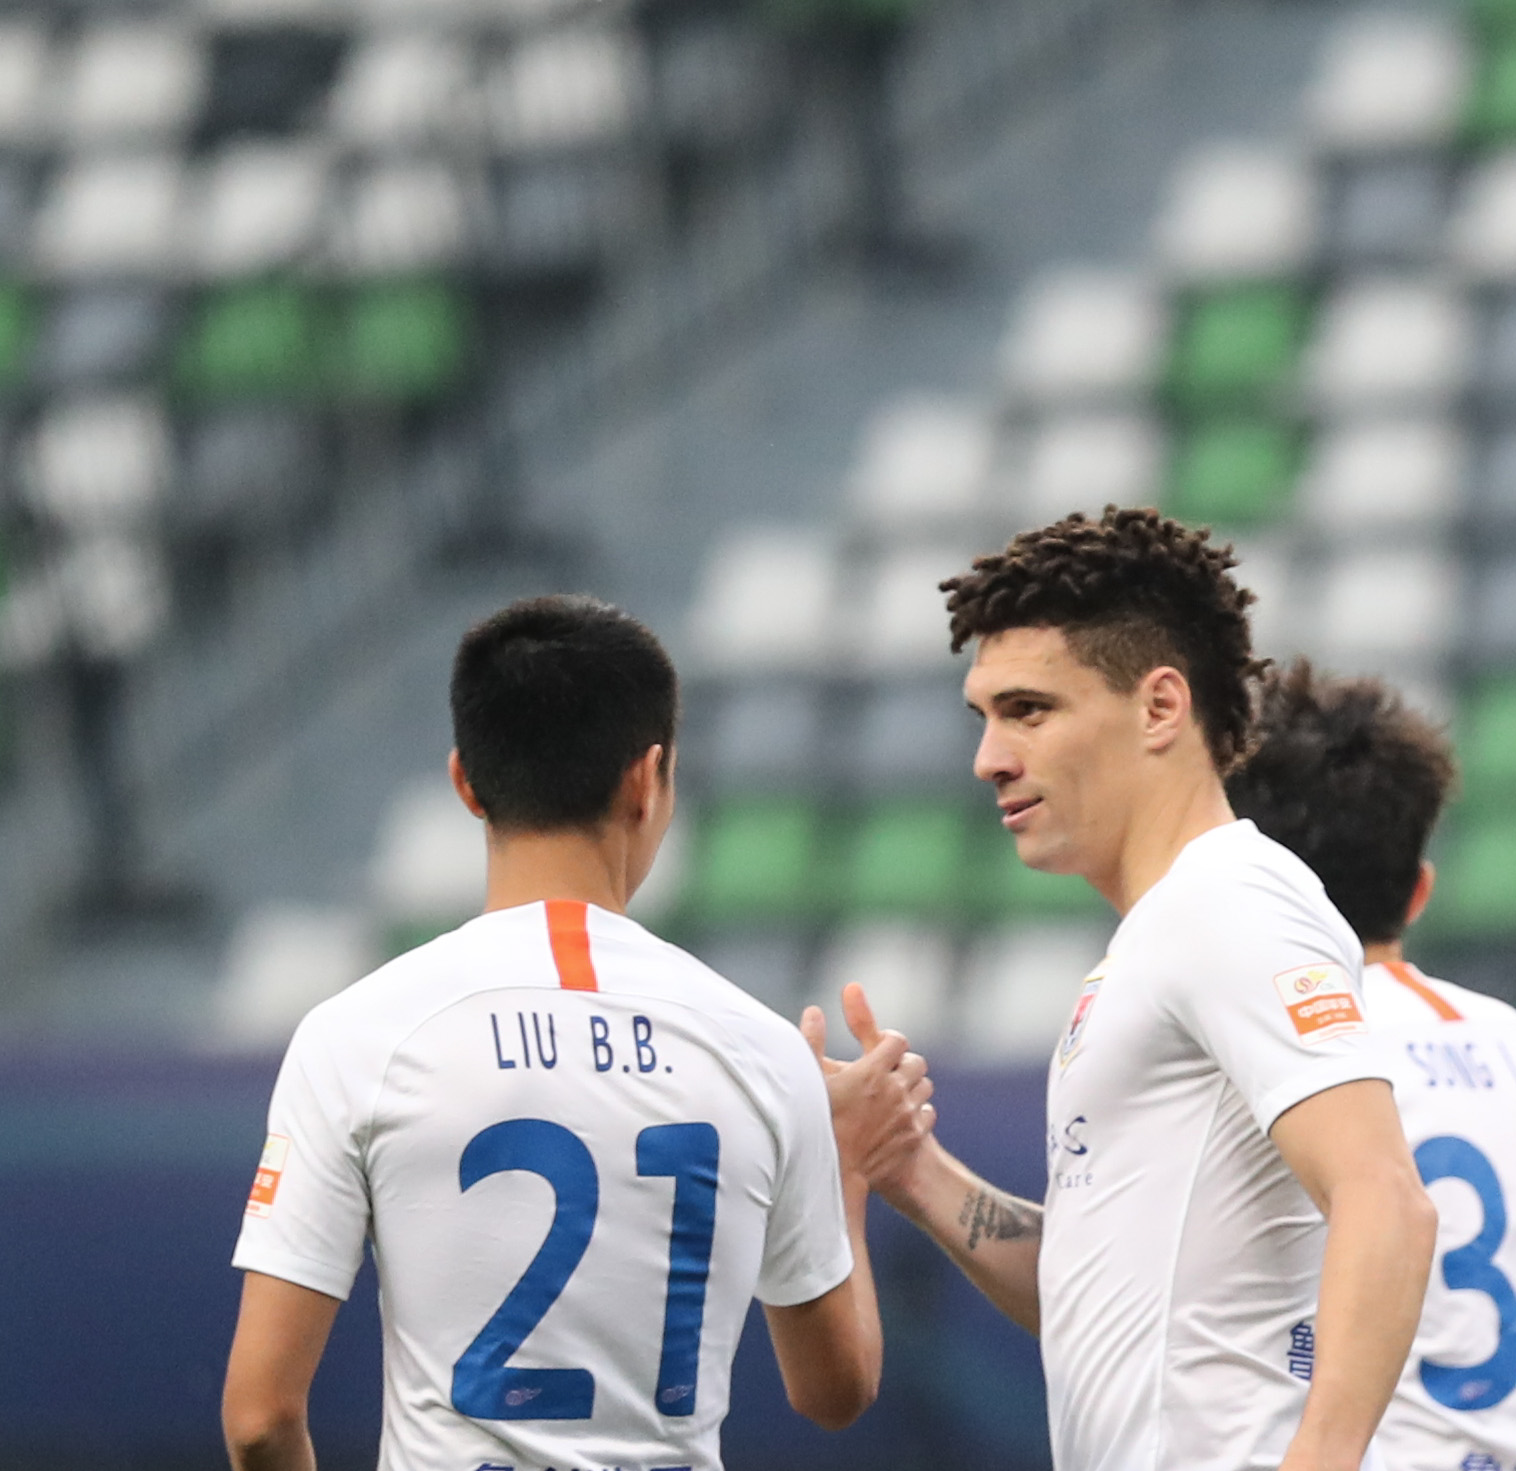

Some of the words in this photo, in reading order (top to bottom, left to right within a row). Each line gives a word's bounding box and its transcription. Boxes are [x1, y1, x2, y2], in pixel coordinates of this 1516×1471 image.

[491, 1012, 557, 1070] LIU
[591, 1014, 674, 1075] B.B.
[450, 1118, 720, 1421] 21
